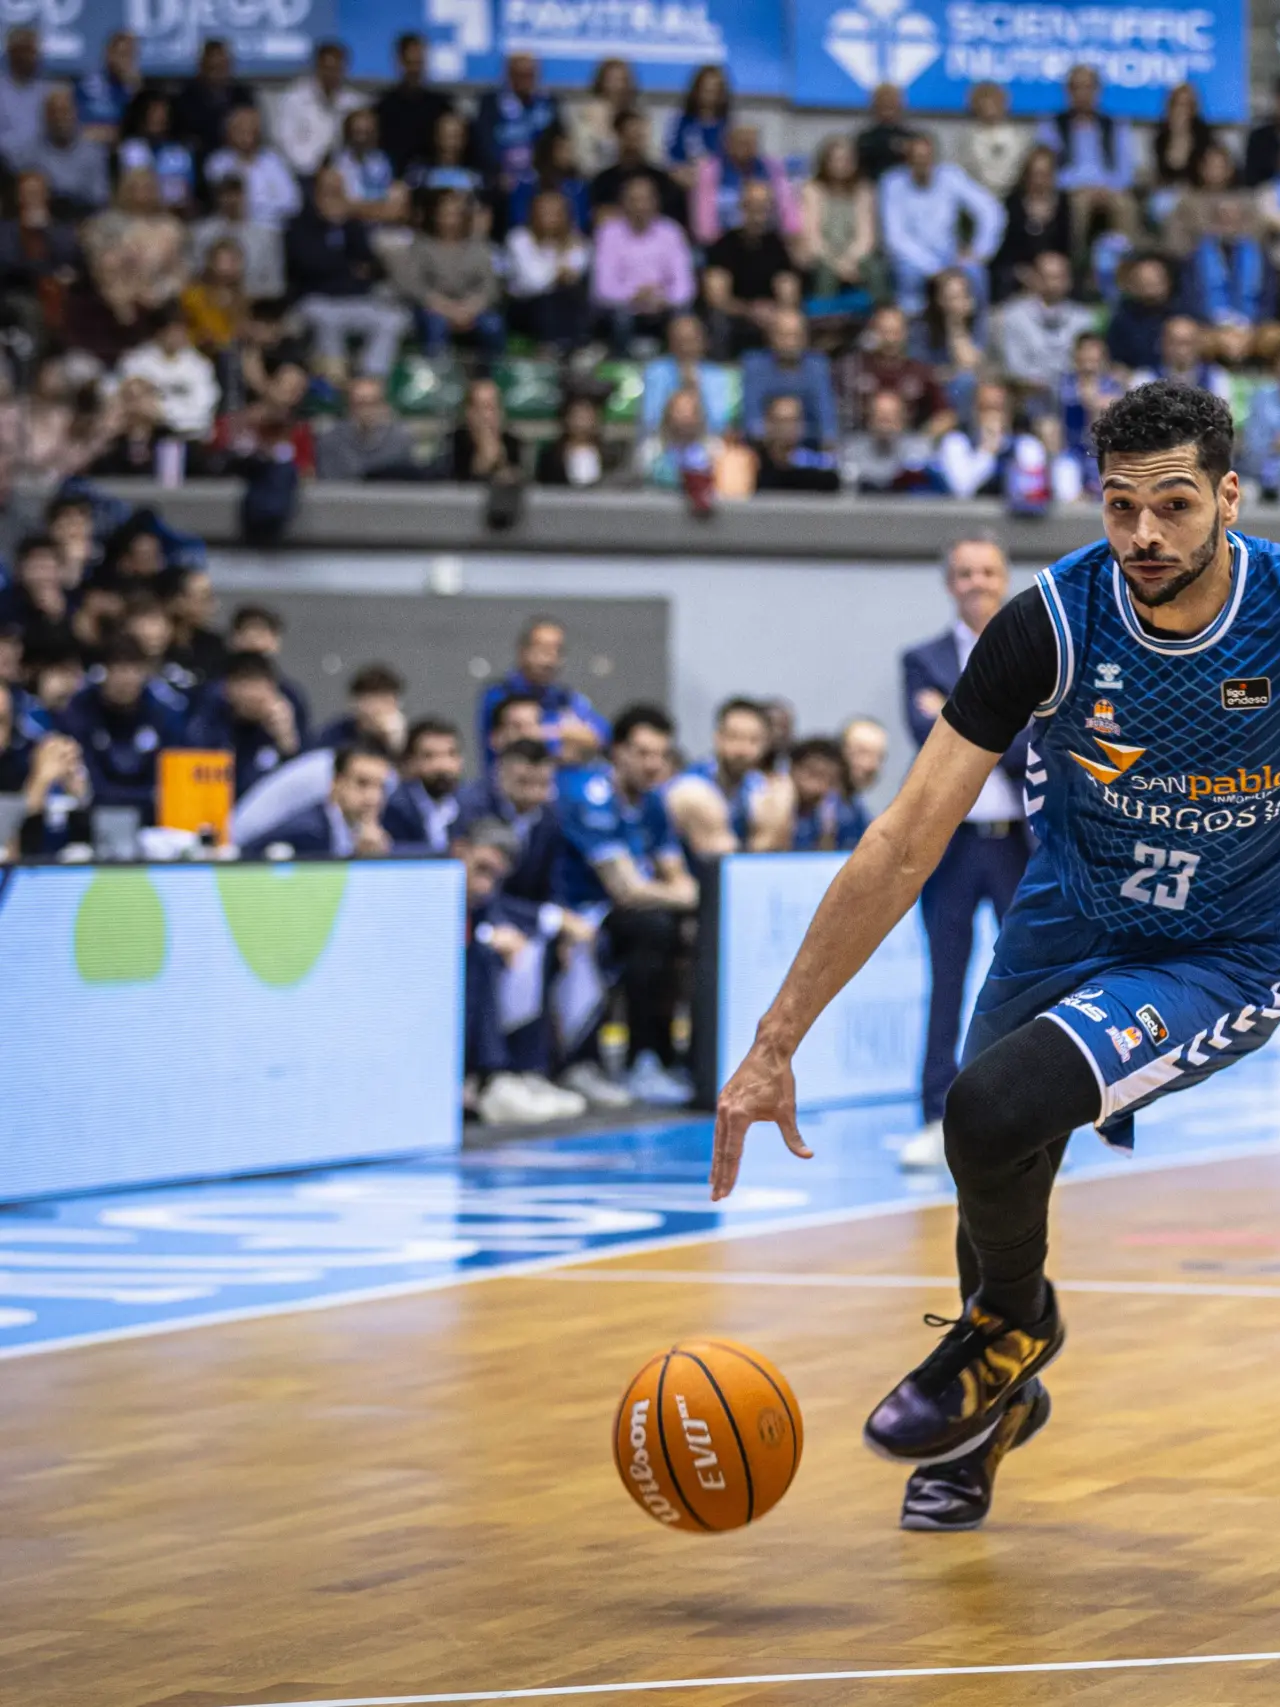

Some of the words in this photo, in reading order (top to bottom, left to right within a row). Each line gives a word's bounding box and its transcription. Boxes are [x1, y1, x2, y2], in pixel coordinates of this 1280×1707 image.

[1227, 696, 1268, 705] endesa
[1120, 841, 1200, 911] 23
[630, 1398, 681, 1522] Wilson
